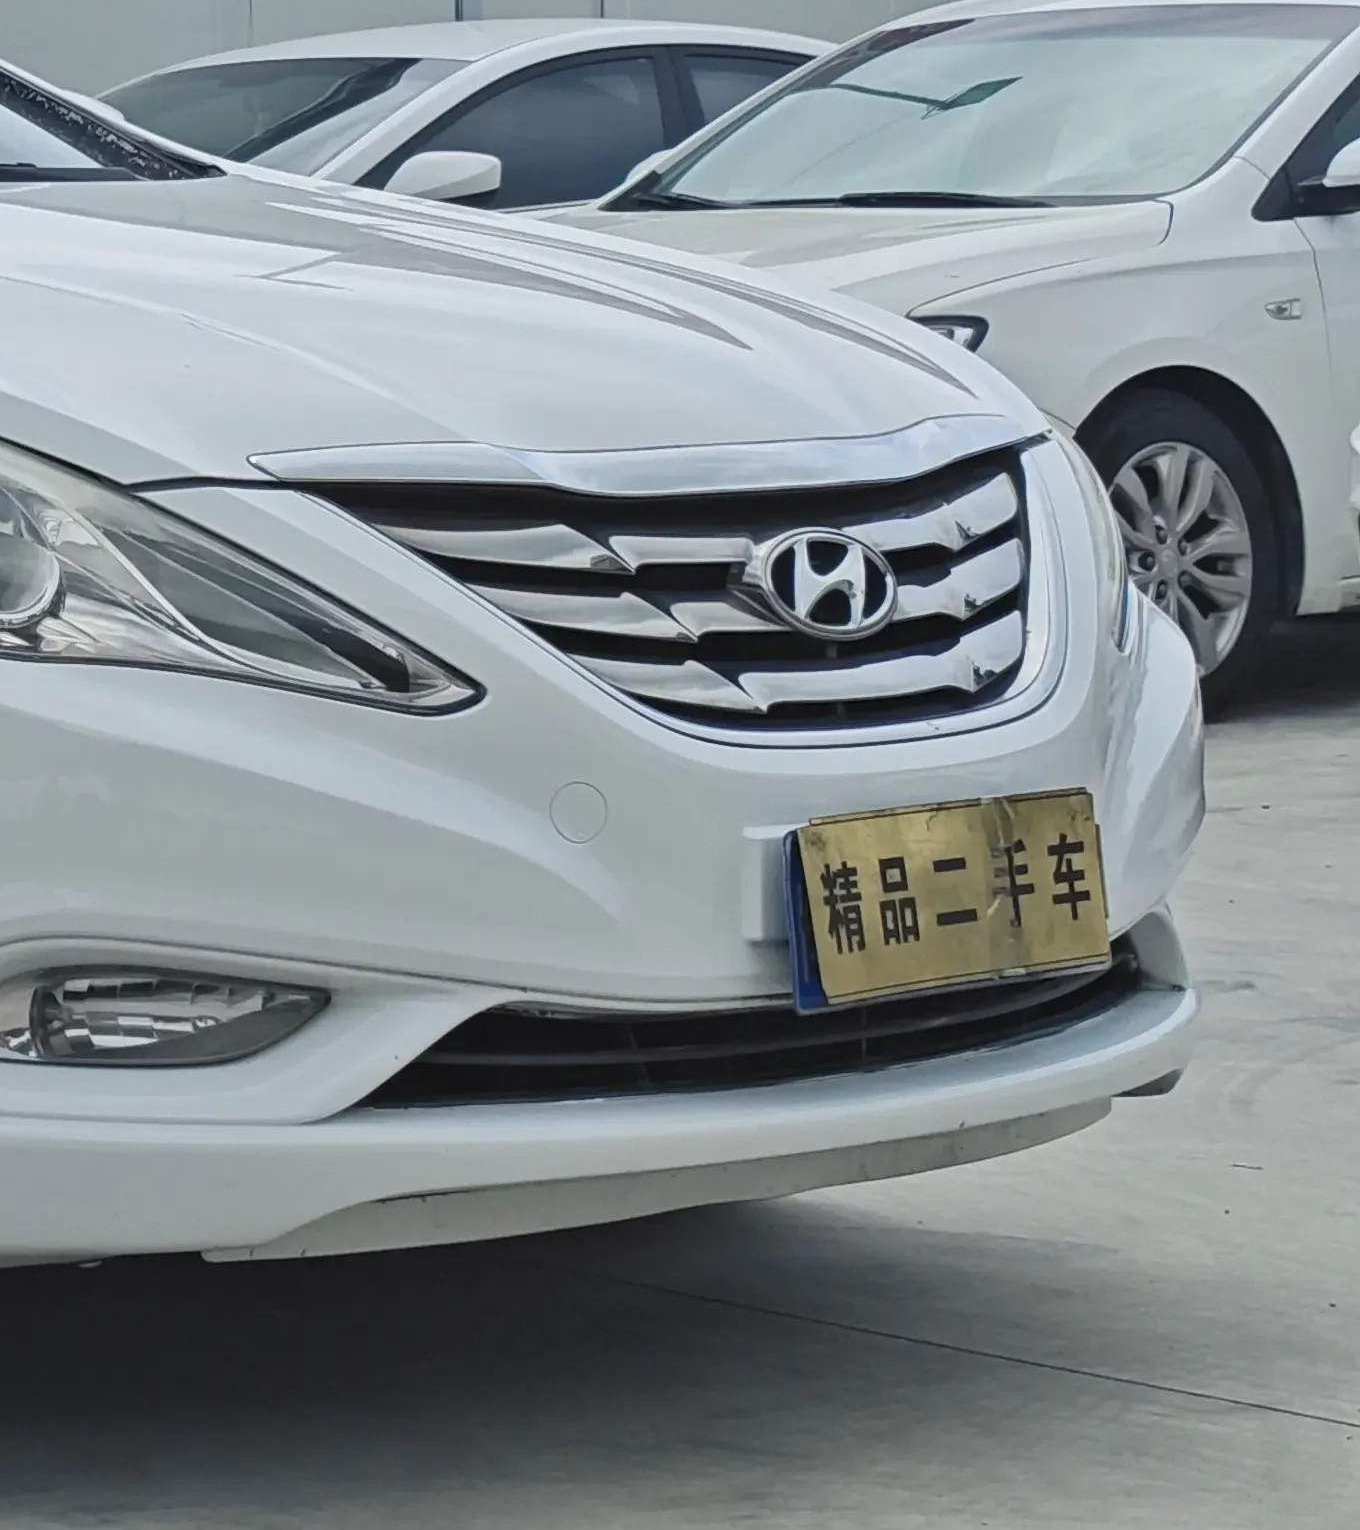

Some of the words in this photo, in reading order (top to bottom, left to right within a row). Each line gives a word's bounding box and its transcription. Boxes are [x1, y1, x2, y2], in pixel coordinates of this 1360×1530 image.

[820, 832, 1091, 956] 精品二手车
